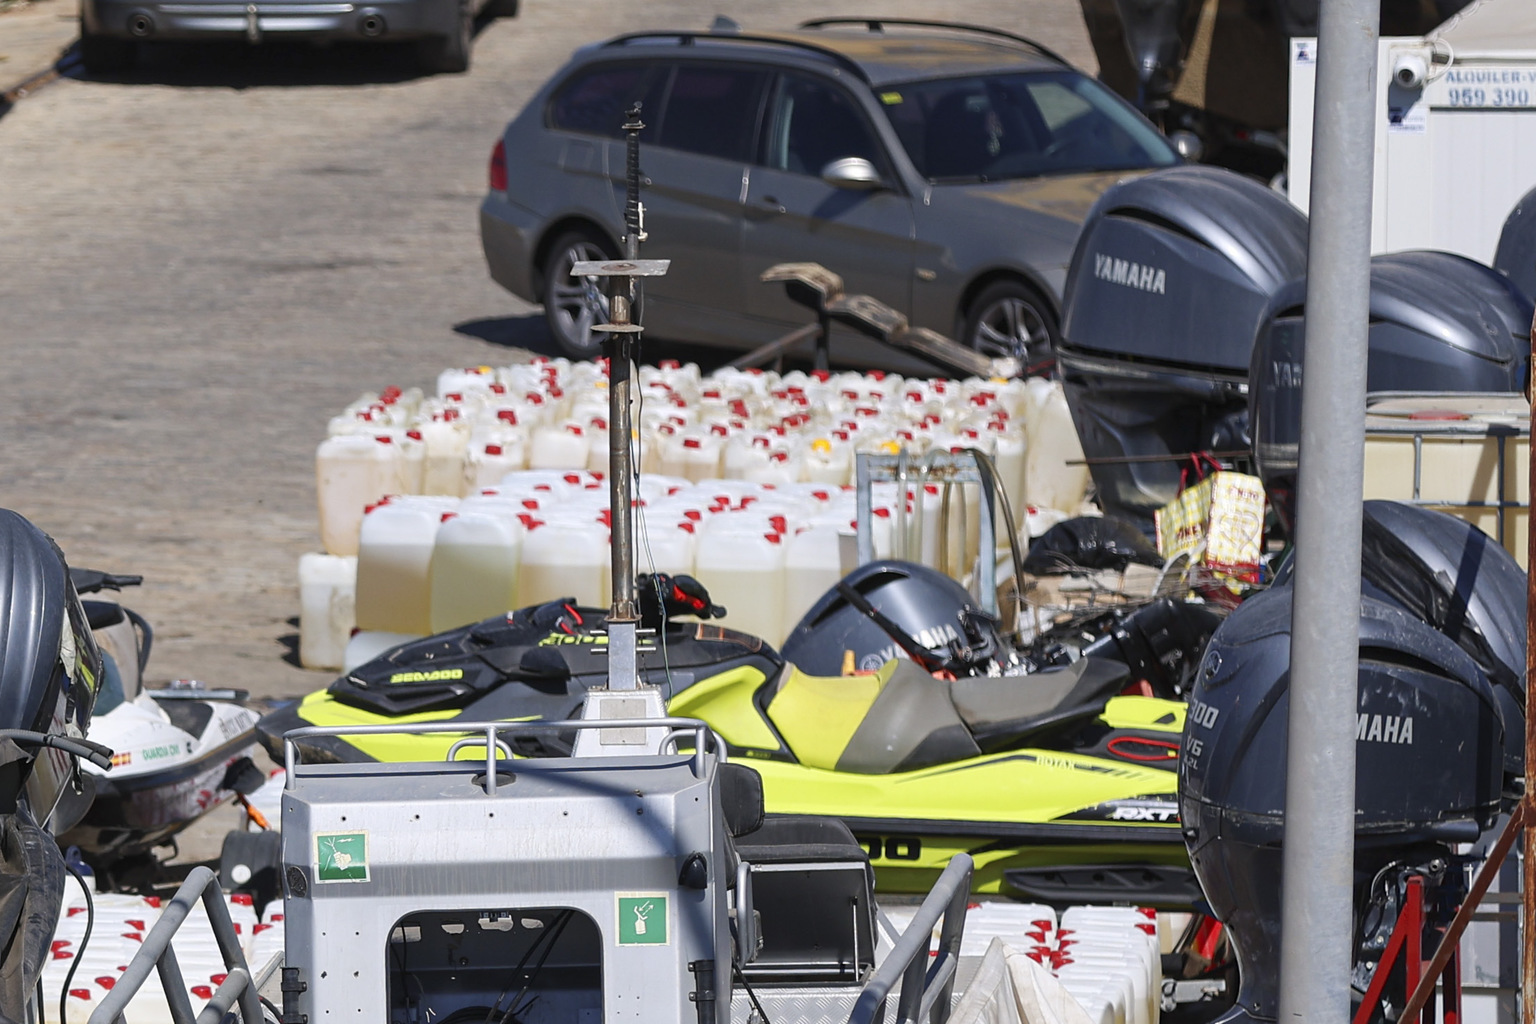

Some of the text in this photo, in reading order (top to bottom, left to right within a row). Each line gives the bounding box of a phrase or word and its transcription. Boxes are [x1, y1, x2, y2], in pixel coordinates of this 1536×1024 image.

[1449, 88, 1529, 107] 959 390
[1094, 252, 1166, 295] YAMAHA
[1186, 735, 1204, 757] V6
[1035, 754, 1076, 771] ROTAX
